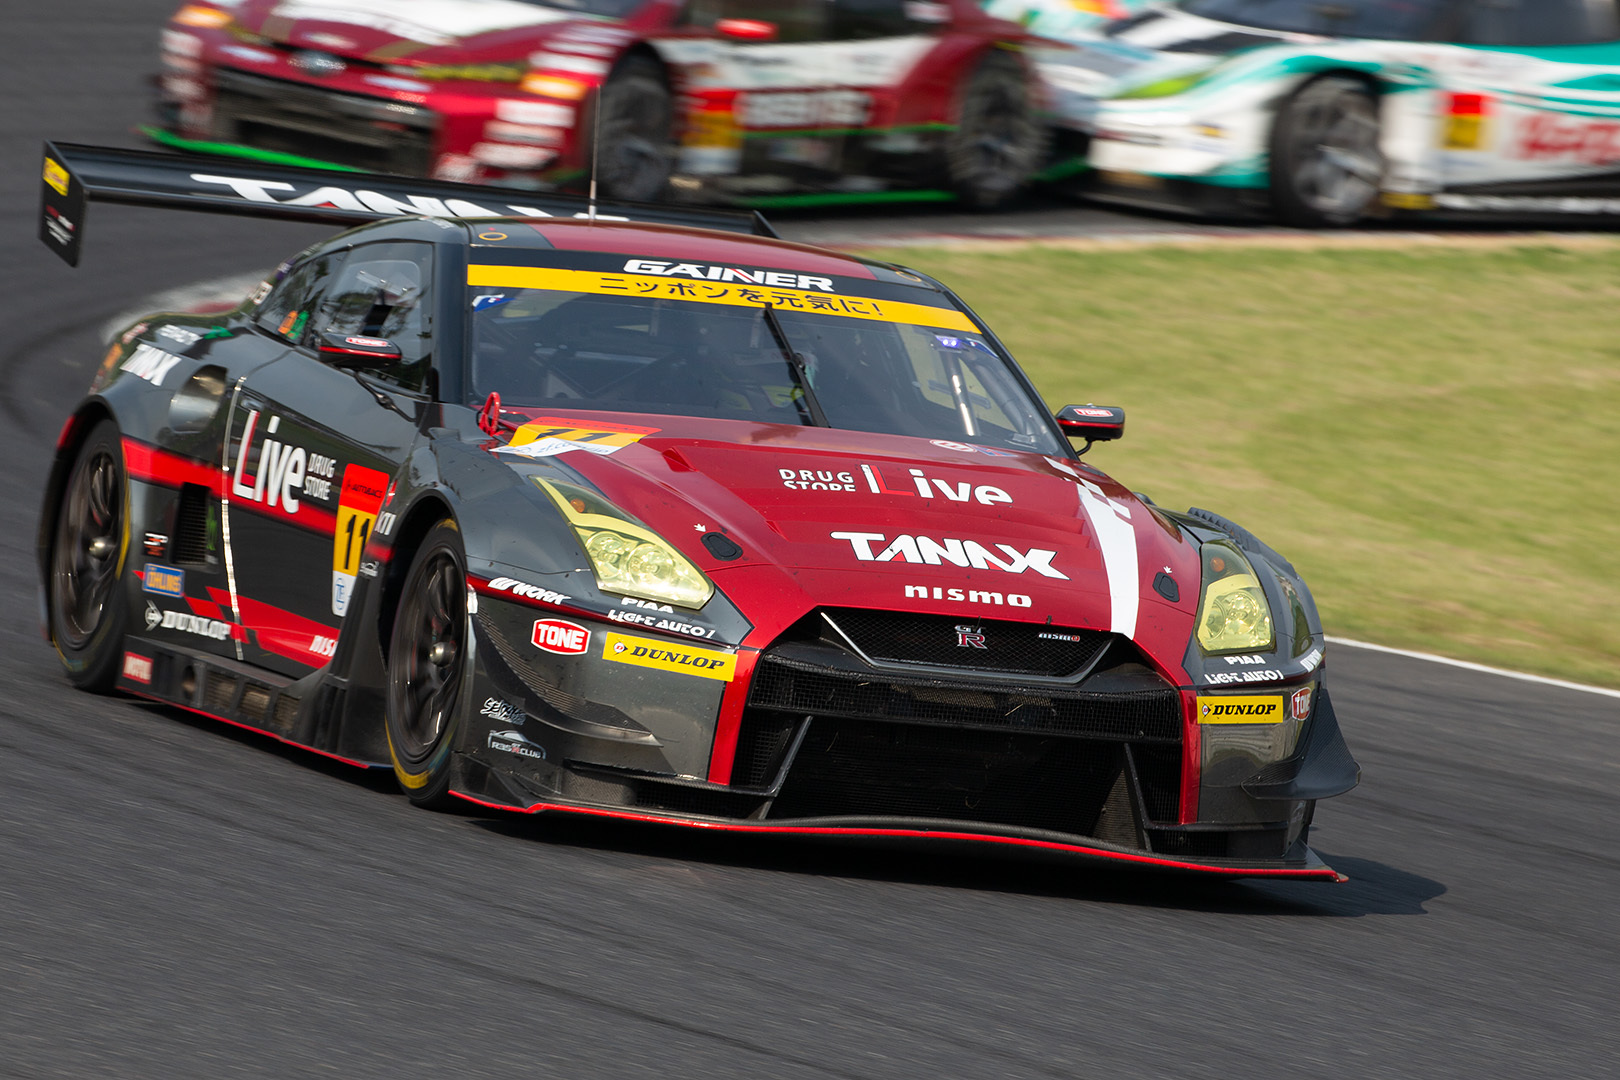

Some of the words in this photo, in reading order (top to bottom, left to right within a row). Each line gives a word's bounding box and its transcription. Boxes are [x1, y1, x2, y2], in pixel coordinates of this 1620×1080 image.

[623, 259, 834, 292] GAINER
[232, 410, 306, 513] Live
[307, 453, 336, 478] DRUG
[303, 475, 331, 501] STORE
[778, 468, 854, 483] DRUG
[860, 464, 1014, 506] Live
[345, 514, 371, 570] 11
[829, 531, 1072, 580] TANAX
[620, 596, 674, 614] PIAA
[160, 610, 232, 641] DUNLOP
[536, 623, 586, 651] TONE
[630, 645, 726, 671] DUNLOP
[1223, 655, 1267, 665] PIAA
[1212, 704, 1277, 716] DUNLOP
